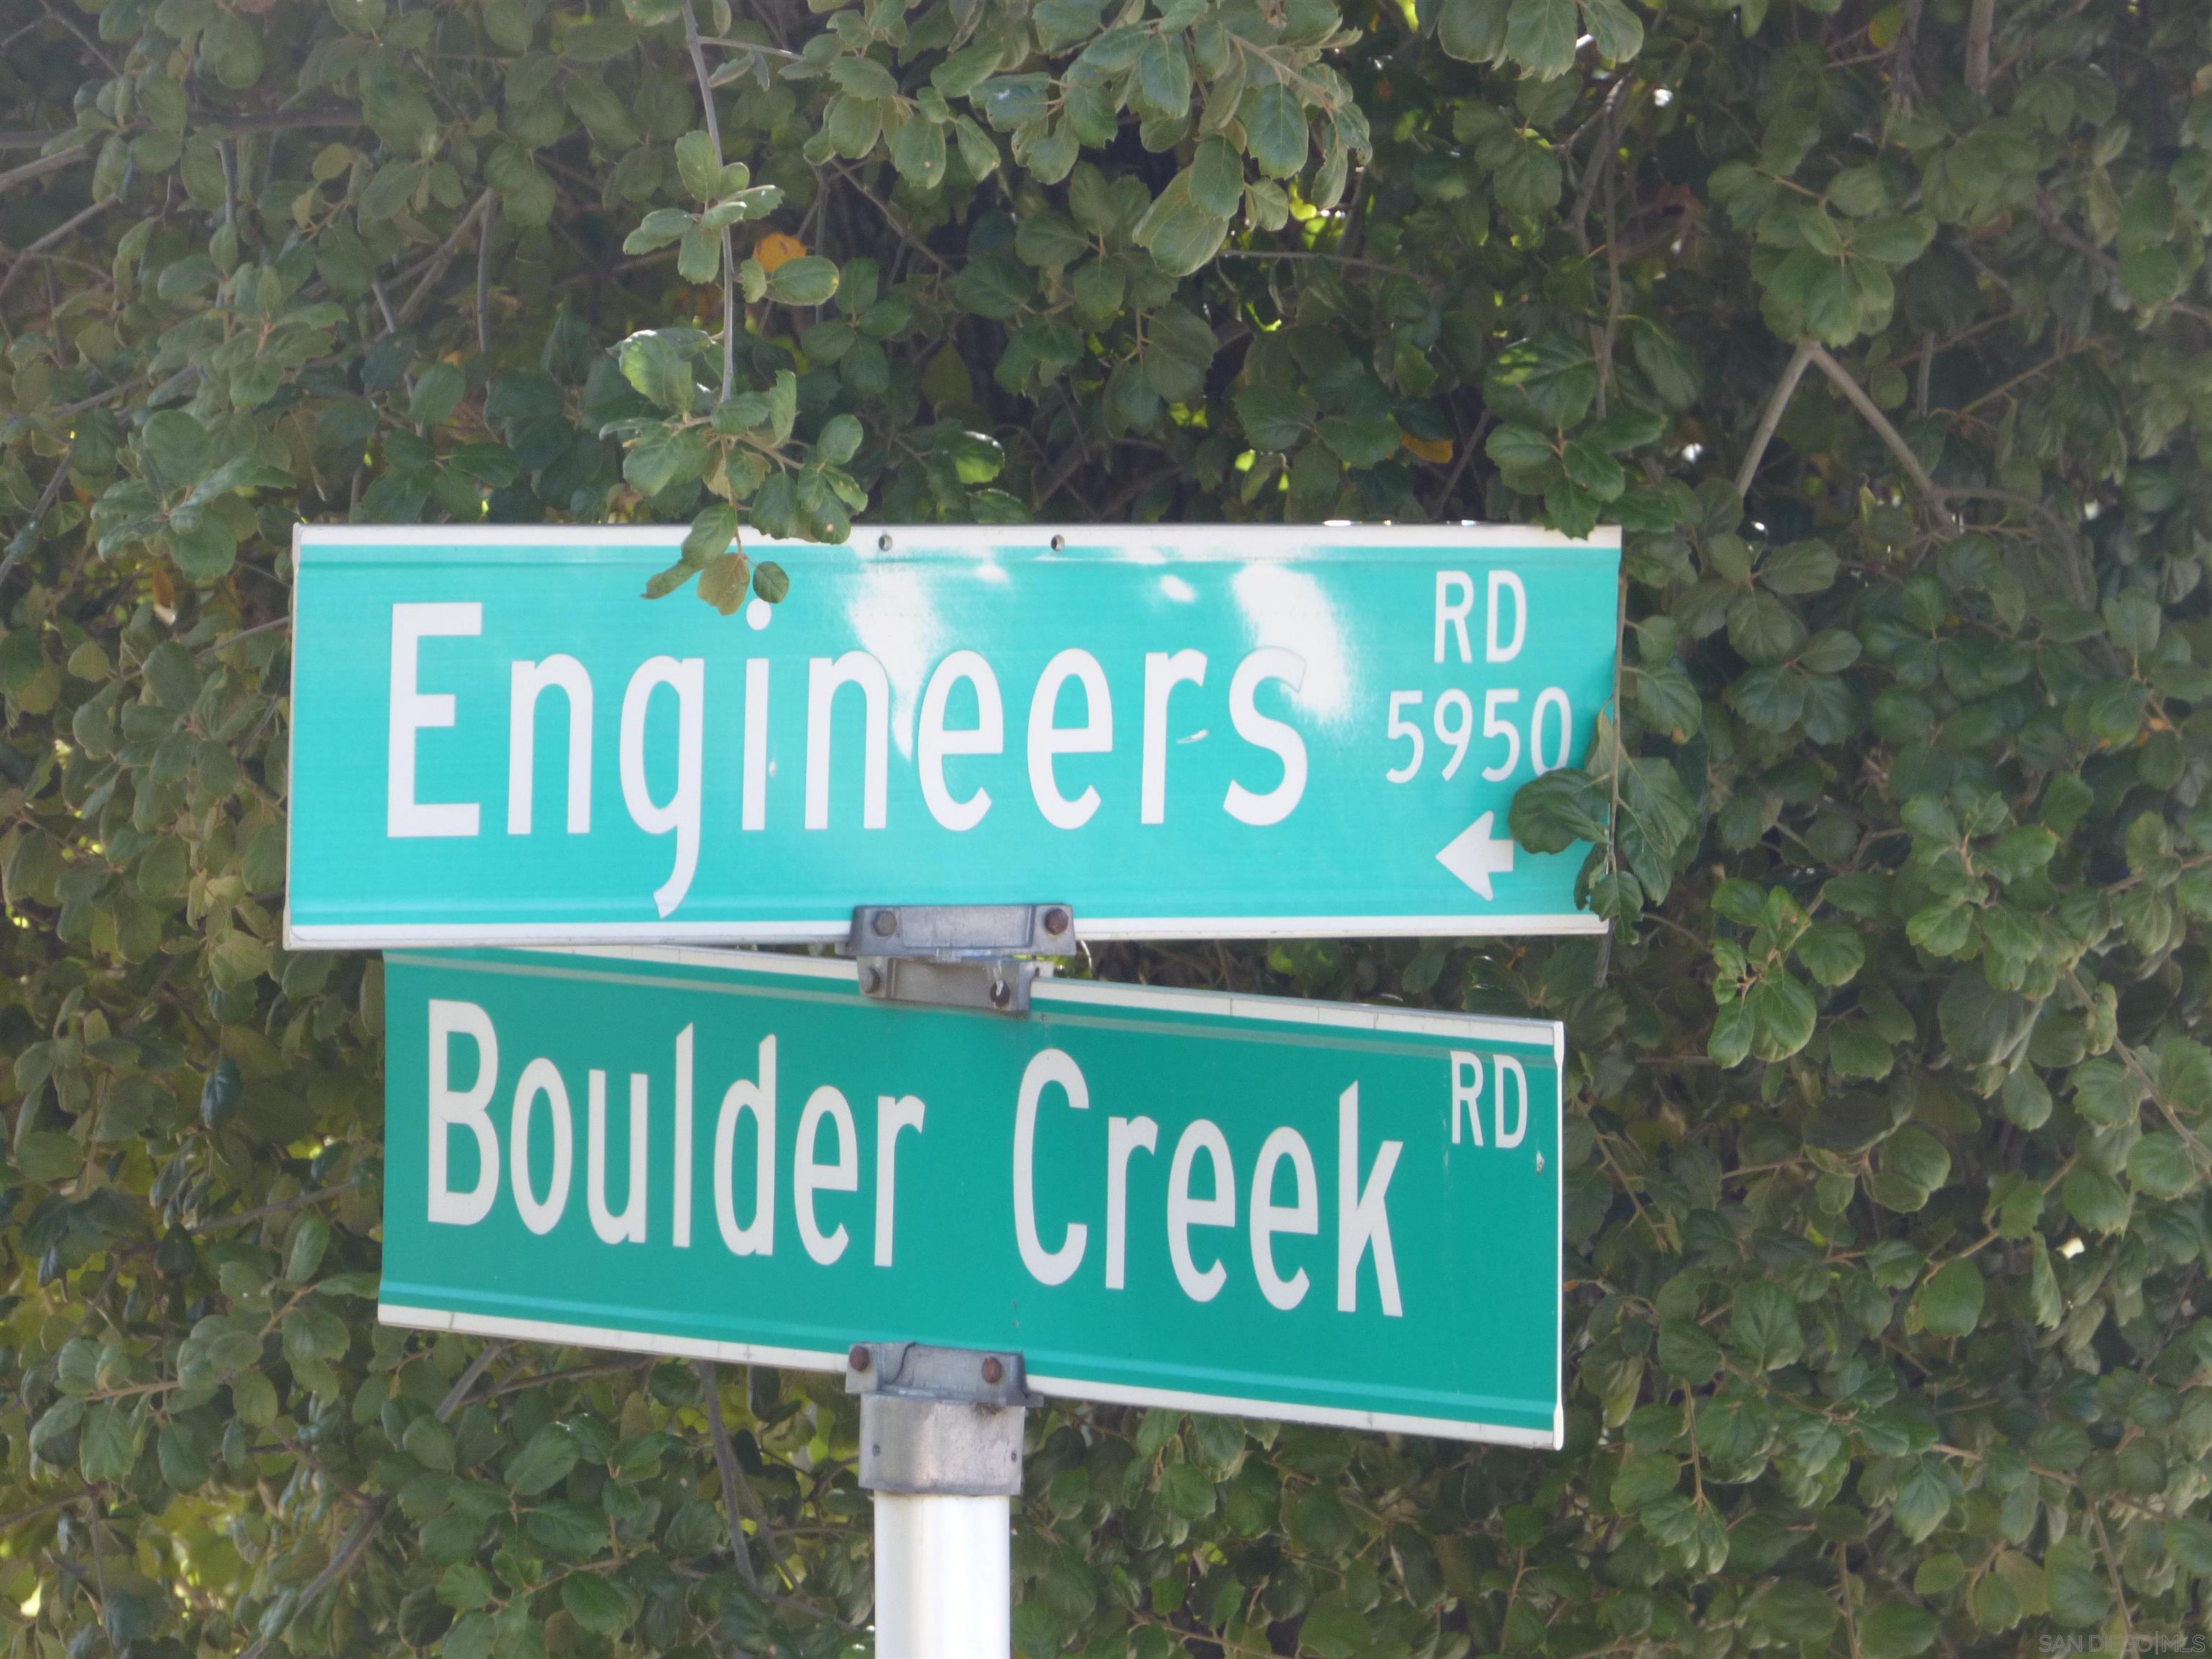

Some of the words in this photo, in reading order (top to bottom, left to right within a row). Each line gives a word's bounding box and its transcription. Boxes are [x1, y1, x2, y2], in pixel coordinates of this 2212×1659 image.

[1434, 570, 1527, 663] RD
[387, 598, 1308, 918] Engineers
[1386, 686, 1572, 783] 5950
[1450, 1051, 1528, 1148] RD
[428, 999, 925, 1267] Boulder
[1013, 1048, 1403, 1317] Creek
